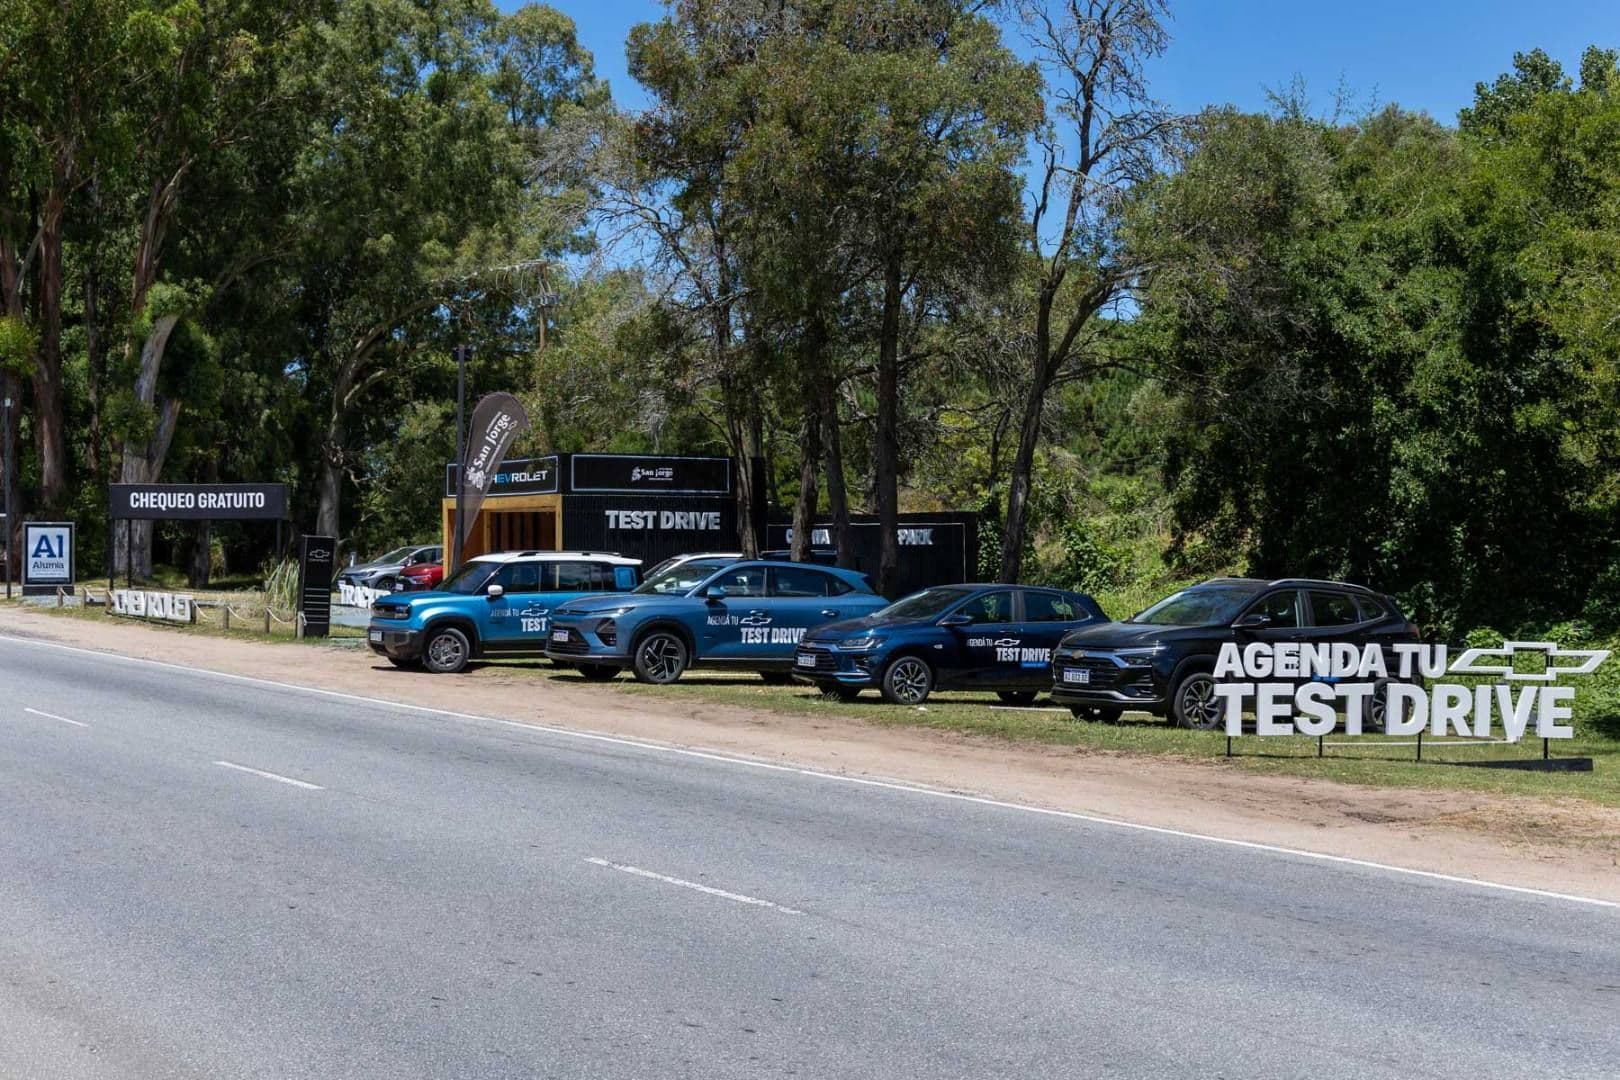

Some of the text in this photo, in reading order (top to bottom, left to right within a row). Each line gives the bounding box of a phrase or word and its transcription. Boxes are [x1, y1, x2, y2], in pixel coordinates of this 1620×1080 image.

[473, 445, 491, 469] San
[485, 413, 511, 446] Jorge
[491, 470, 548, 485] HEVROLET
[130, 491, 265, 511] CHEQUEO GRATUITO
[605, 510, 721, 530] TEST DRIVE
[520, 617, 548, 632] TEST
[731, 615, 739, 625] TU
[740, 627, 770, 644] TEST
[996, 647, 1051, 662] TEST DRIVE
[1213, 642, 1388, 678] AGENDA
[1392, 643, 1448, 679] TU
[1213, 682, 1576, 743] TEST DRIVE
